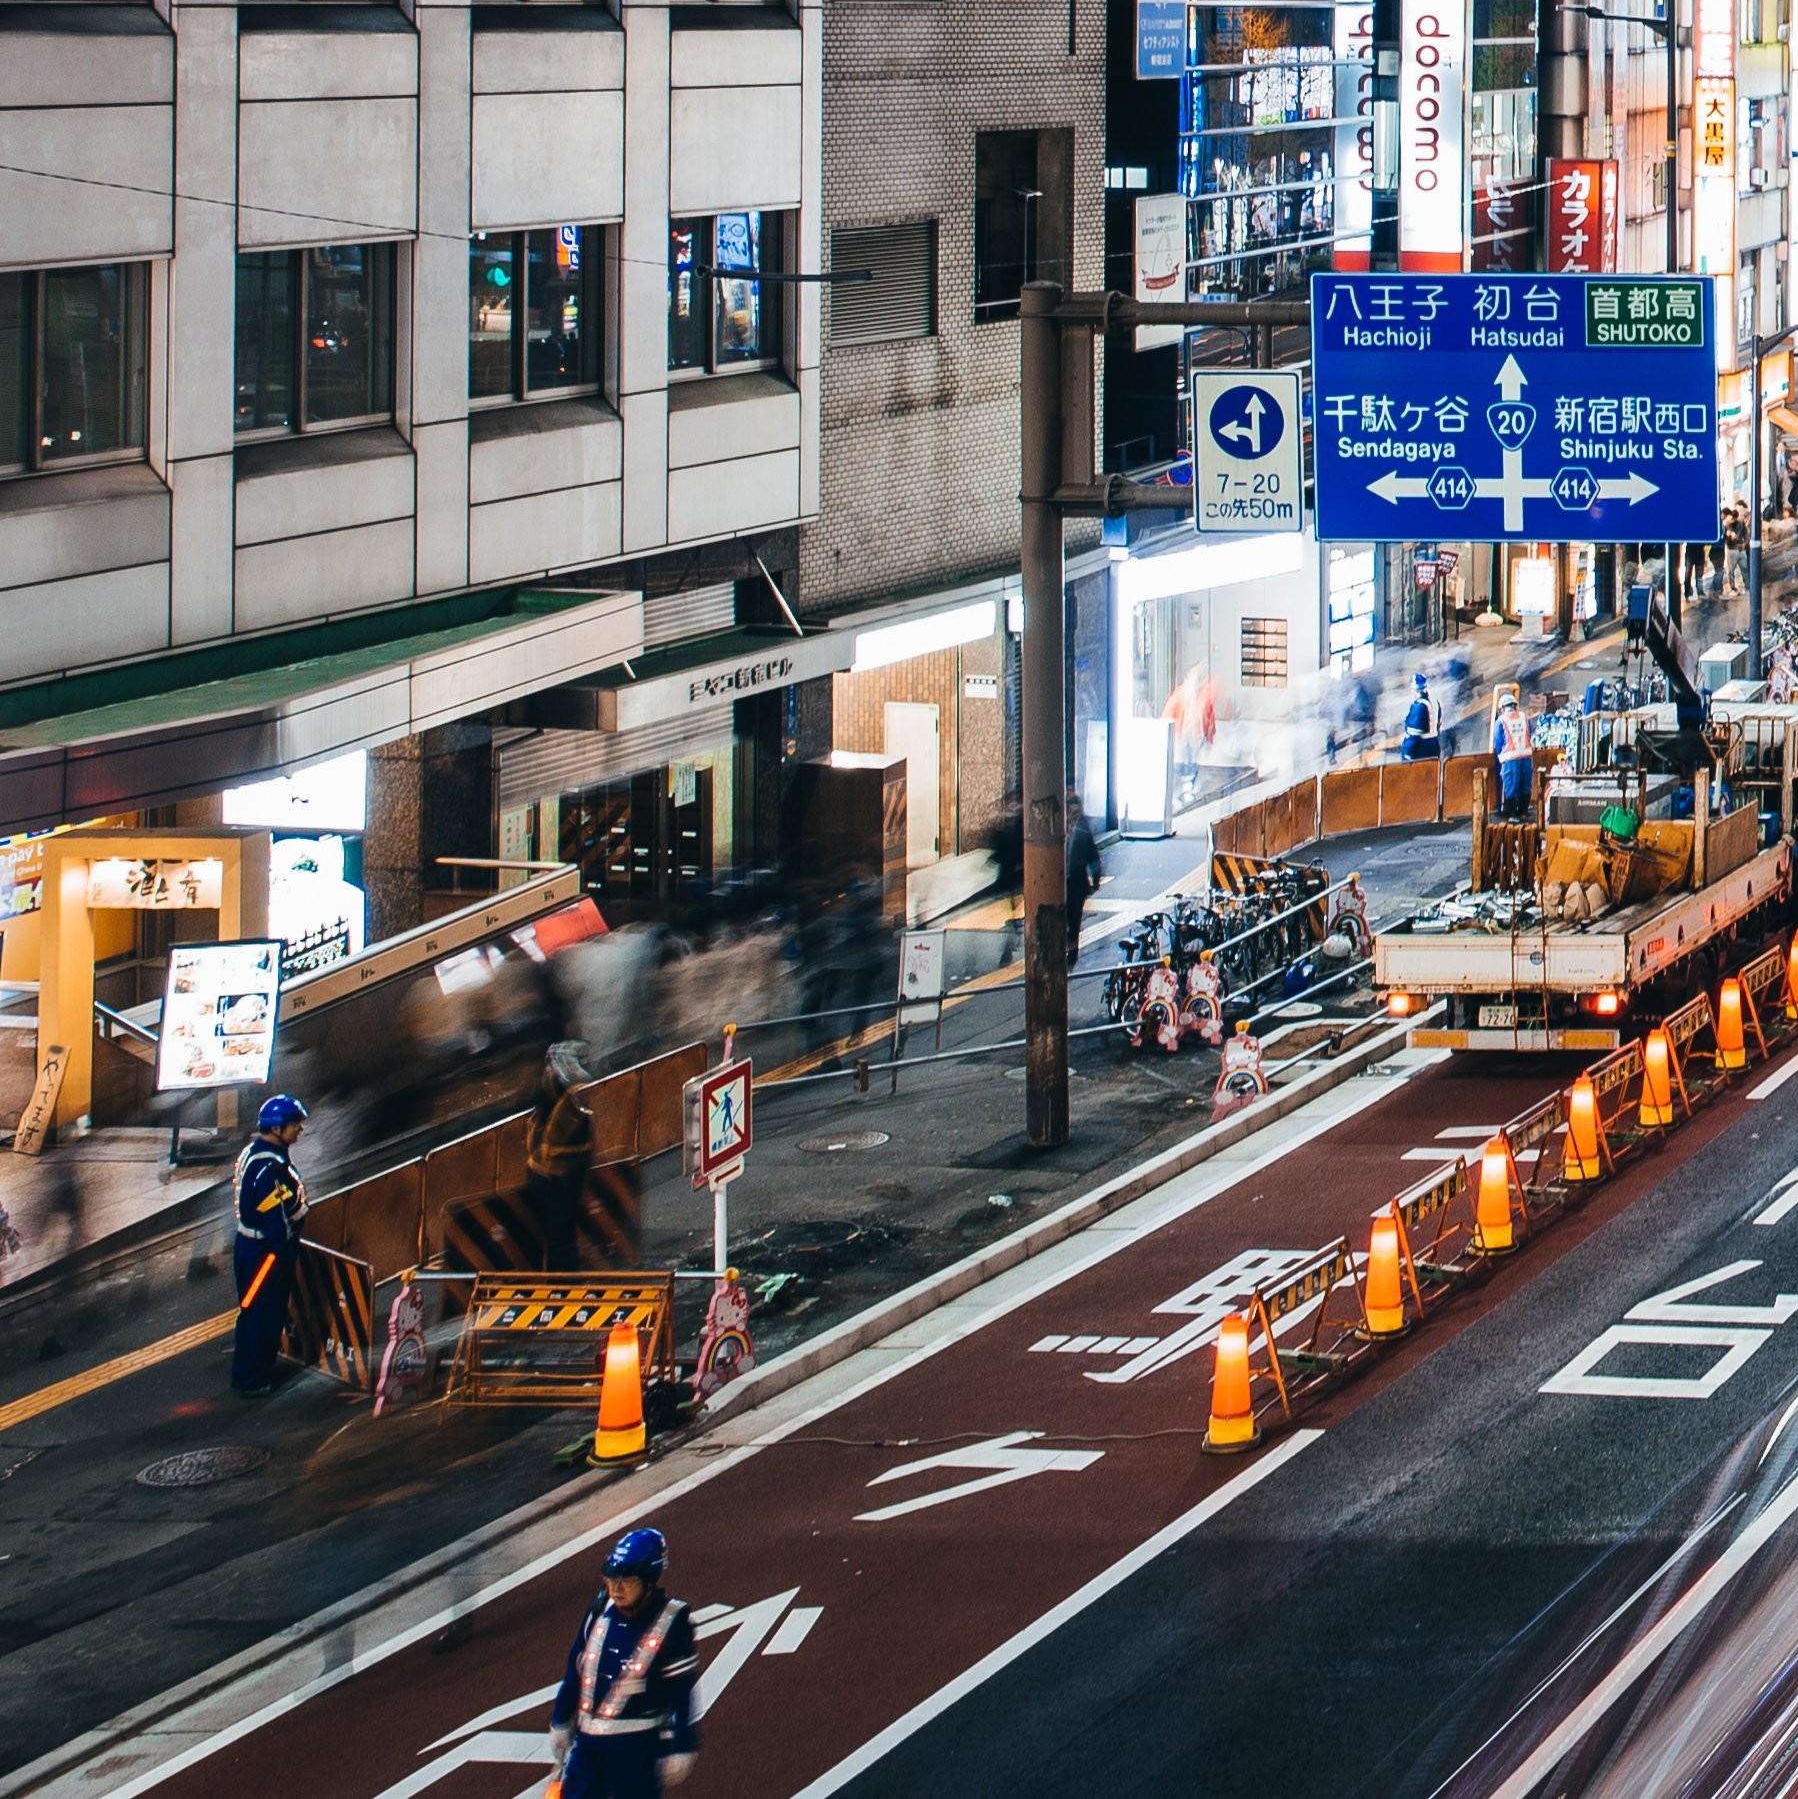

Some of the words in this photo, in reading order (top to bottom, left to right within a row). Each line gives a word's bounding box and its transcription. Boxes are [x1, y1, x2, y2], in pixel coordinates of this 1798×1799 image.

[1416, 13, 1449, 193] docomo
[1703, 97, 1728, 168] 大黒屋
[1326, 284, 1449, 322] 八王子
[1473, 284, 1562, 322] 初台
[1590, 287, 1696, 321] 首都高
[1343, 326, 1432, 348] Hachioji
[1470, 326, 1564, 348] Hatsudai
[1597, 324, 1692, 343] SHUTOKO
[1497, 410, 1526, 435] 20
[1554, 396, 1707, 434] 新宿駅西口
[1338, 438, 1456, 464] Sendagaya
[1560, 438, 1654, 462] Shinjuku
[1663, 439, 1704, 460] Sta.
[1215, 473, 1281, 495] 7-20
[1434, 478, 1468, 498] 414
[1558, 478, 1592, 498] 414
[1205, 498, 1293, 521] この先50m
